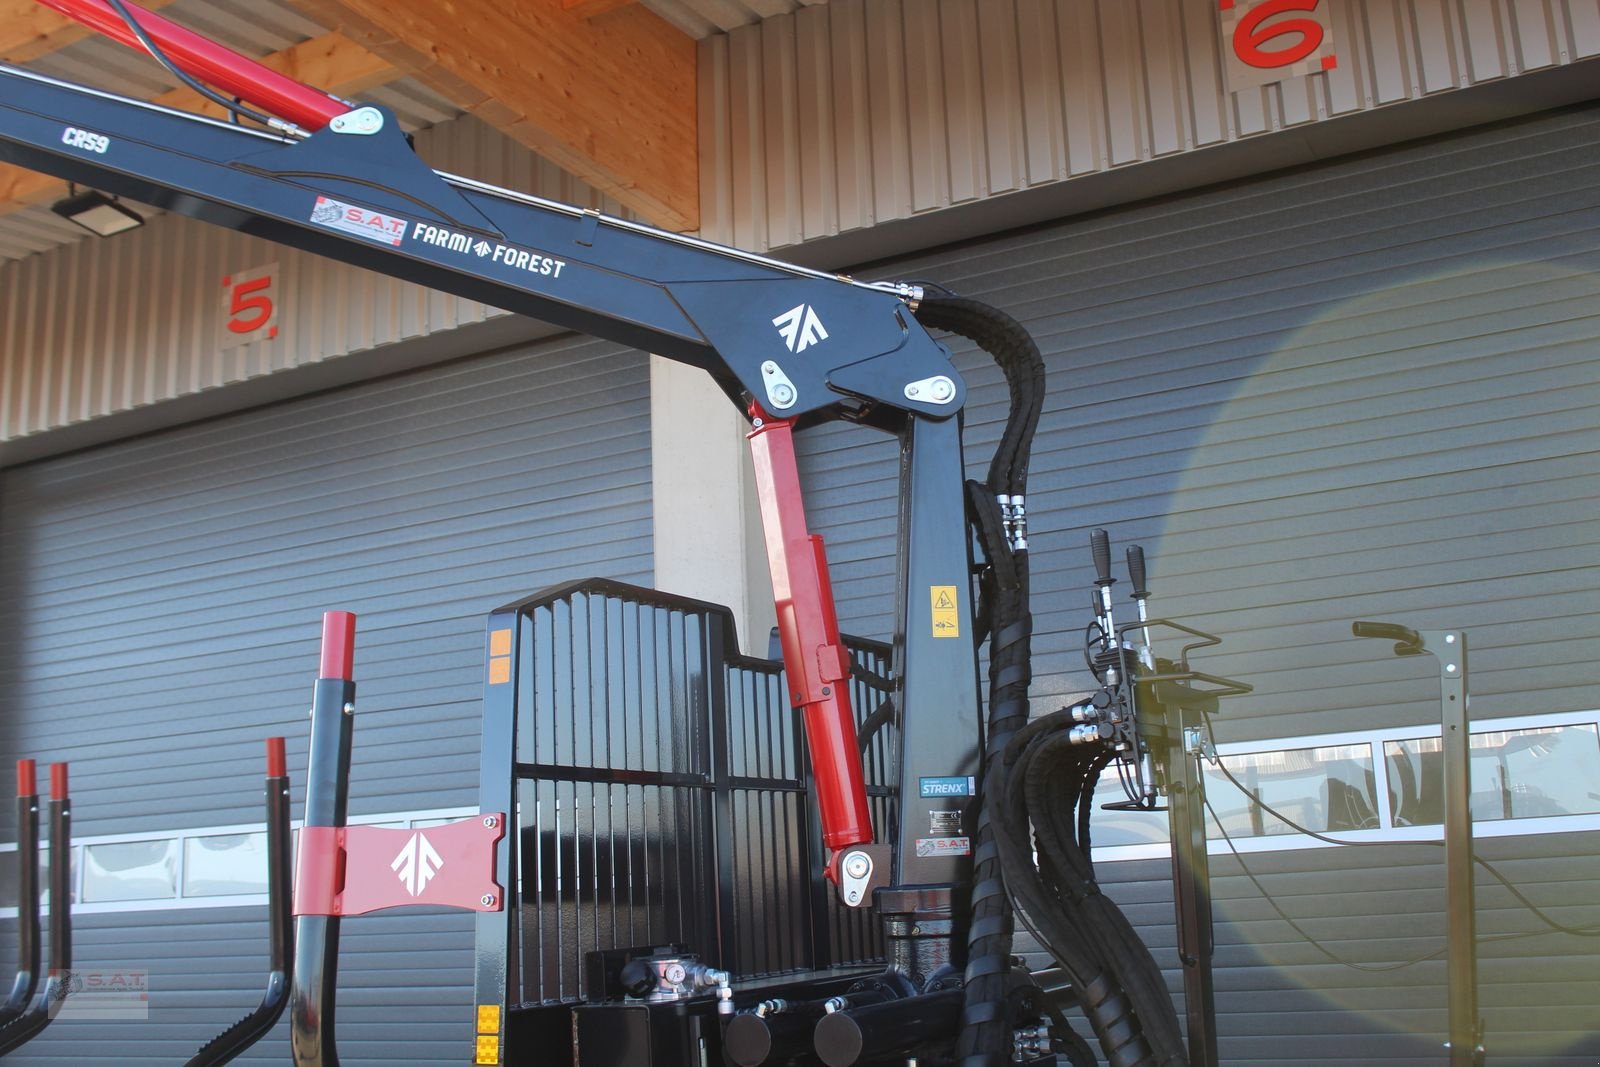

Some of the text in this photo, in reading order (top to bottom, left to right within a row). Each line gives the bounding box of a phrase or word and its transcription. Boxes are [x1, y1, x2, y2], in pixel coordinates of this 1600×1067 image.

[1233, 0, 1323, 69] 6
[346, 208, 402, 235] S.A.T.
[412, 222, 473, 254] FARMI
[492, 244, 566, 278] FOREST
[227, 276, 272, 334] 5
[922, 784, 964, 794] STRENX
